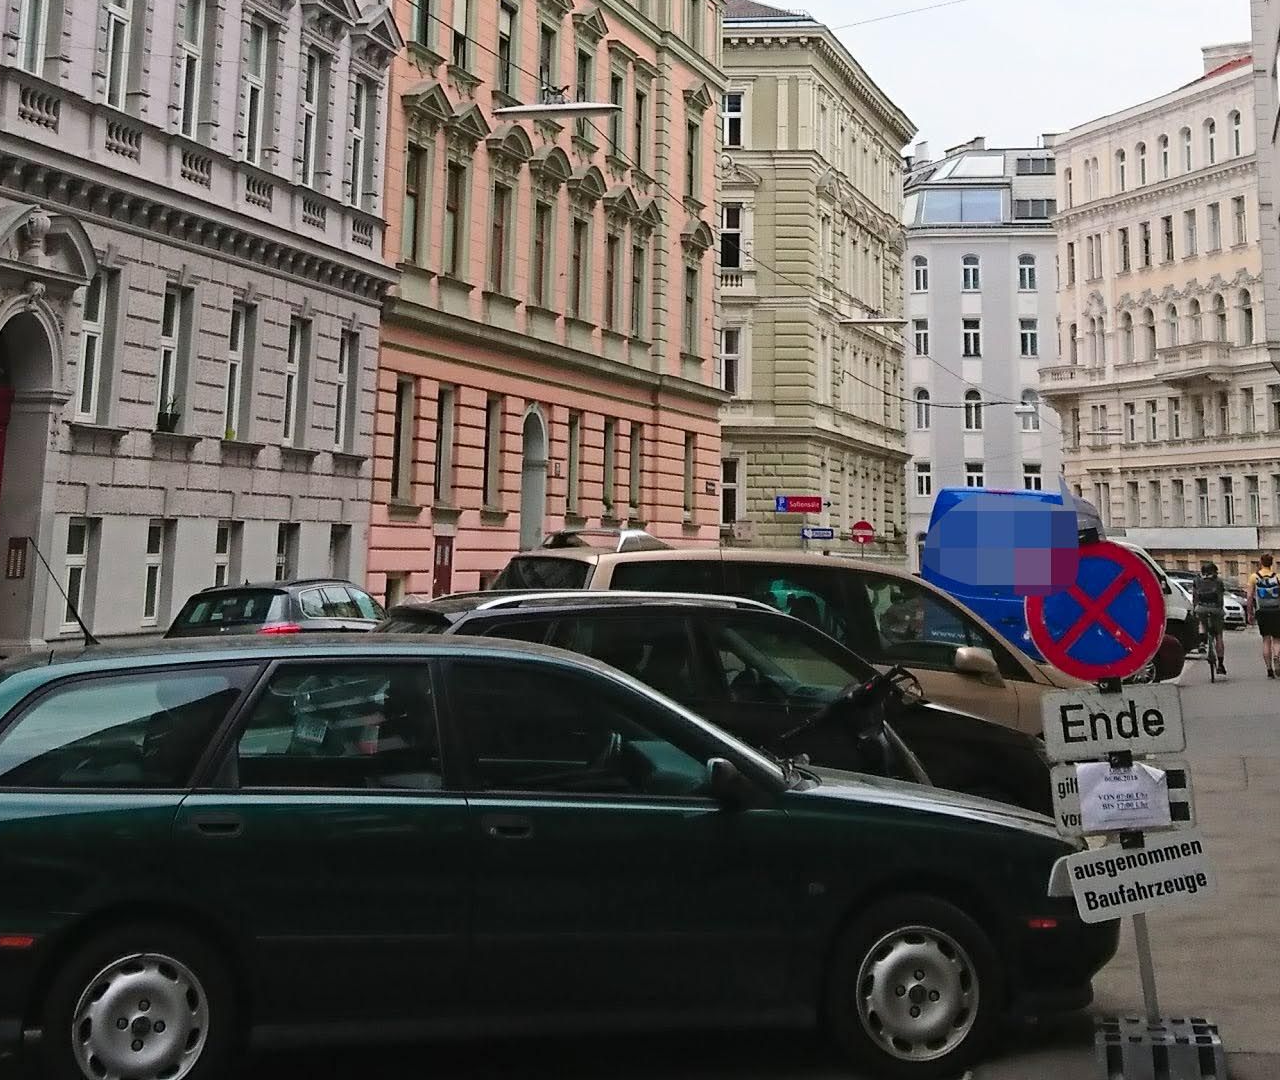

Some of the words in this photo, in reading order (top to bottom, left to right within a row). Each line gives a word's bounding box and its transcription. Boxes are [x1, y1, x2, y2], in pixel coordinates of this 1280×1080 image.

[1060, 700, 1165, 743] Ende
[1073, 840, 1203, 880] ausgenommen
[1084, 872, 1208, 911] Baufahrzeuge
